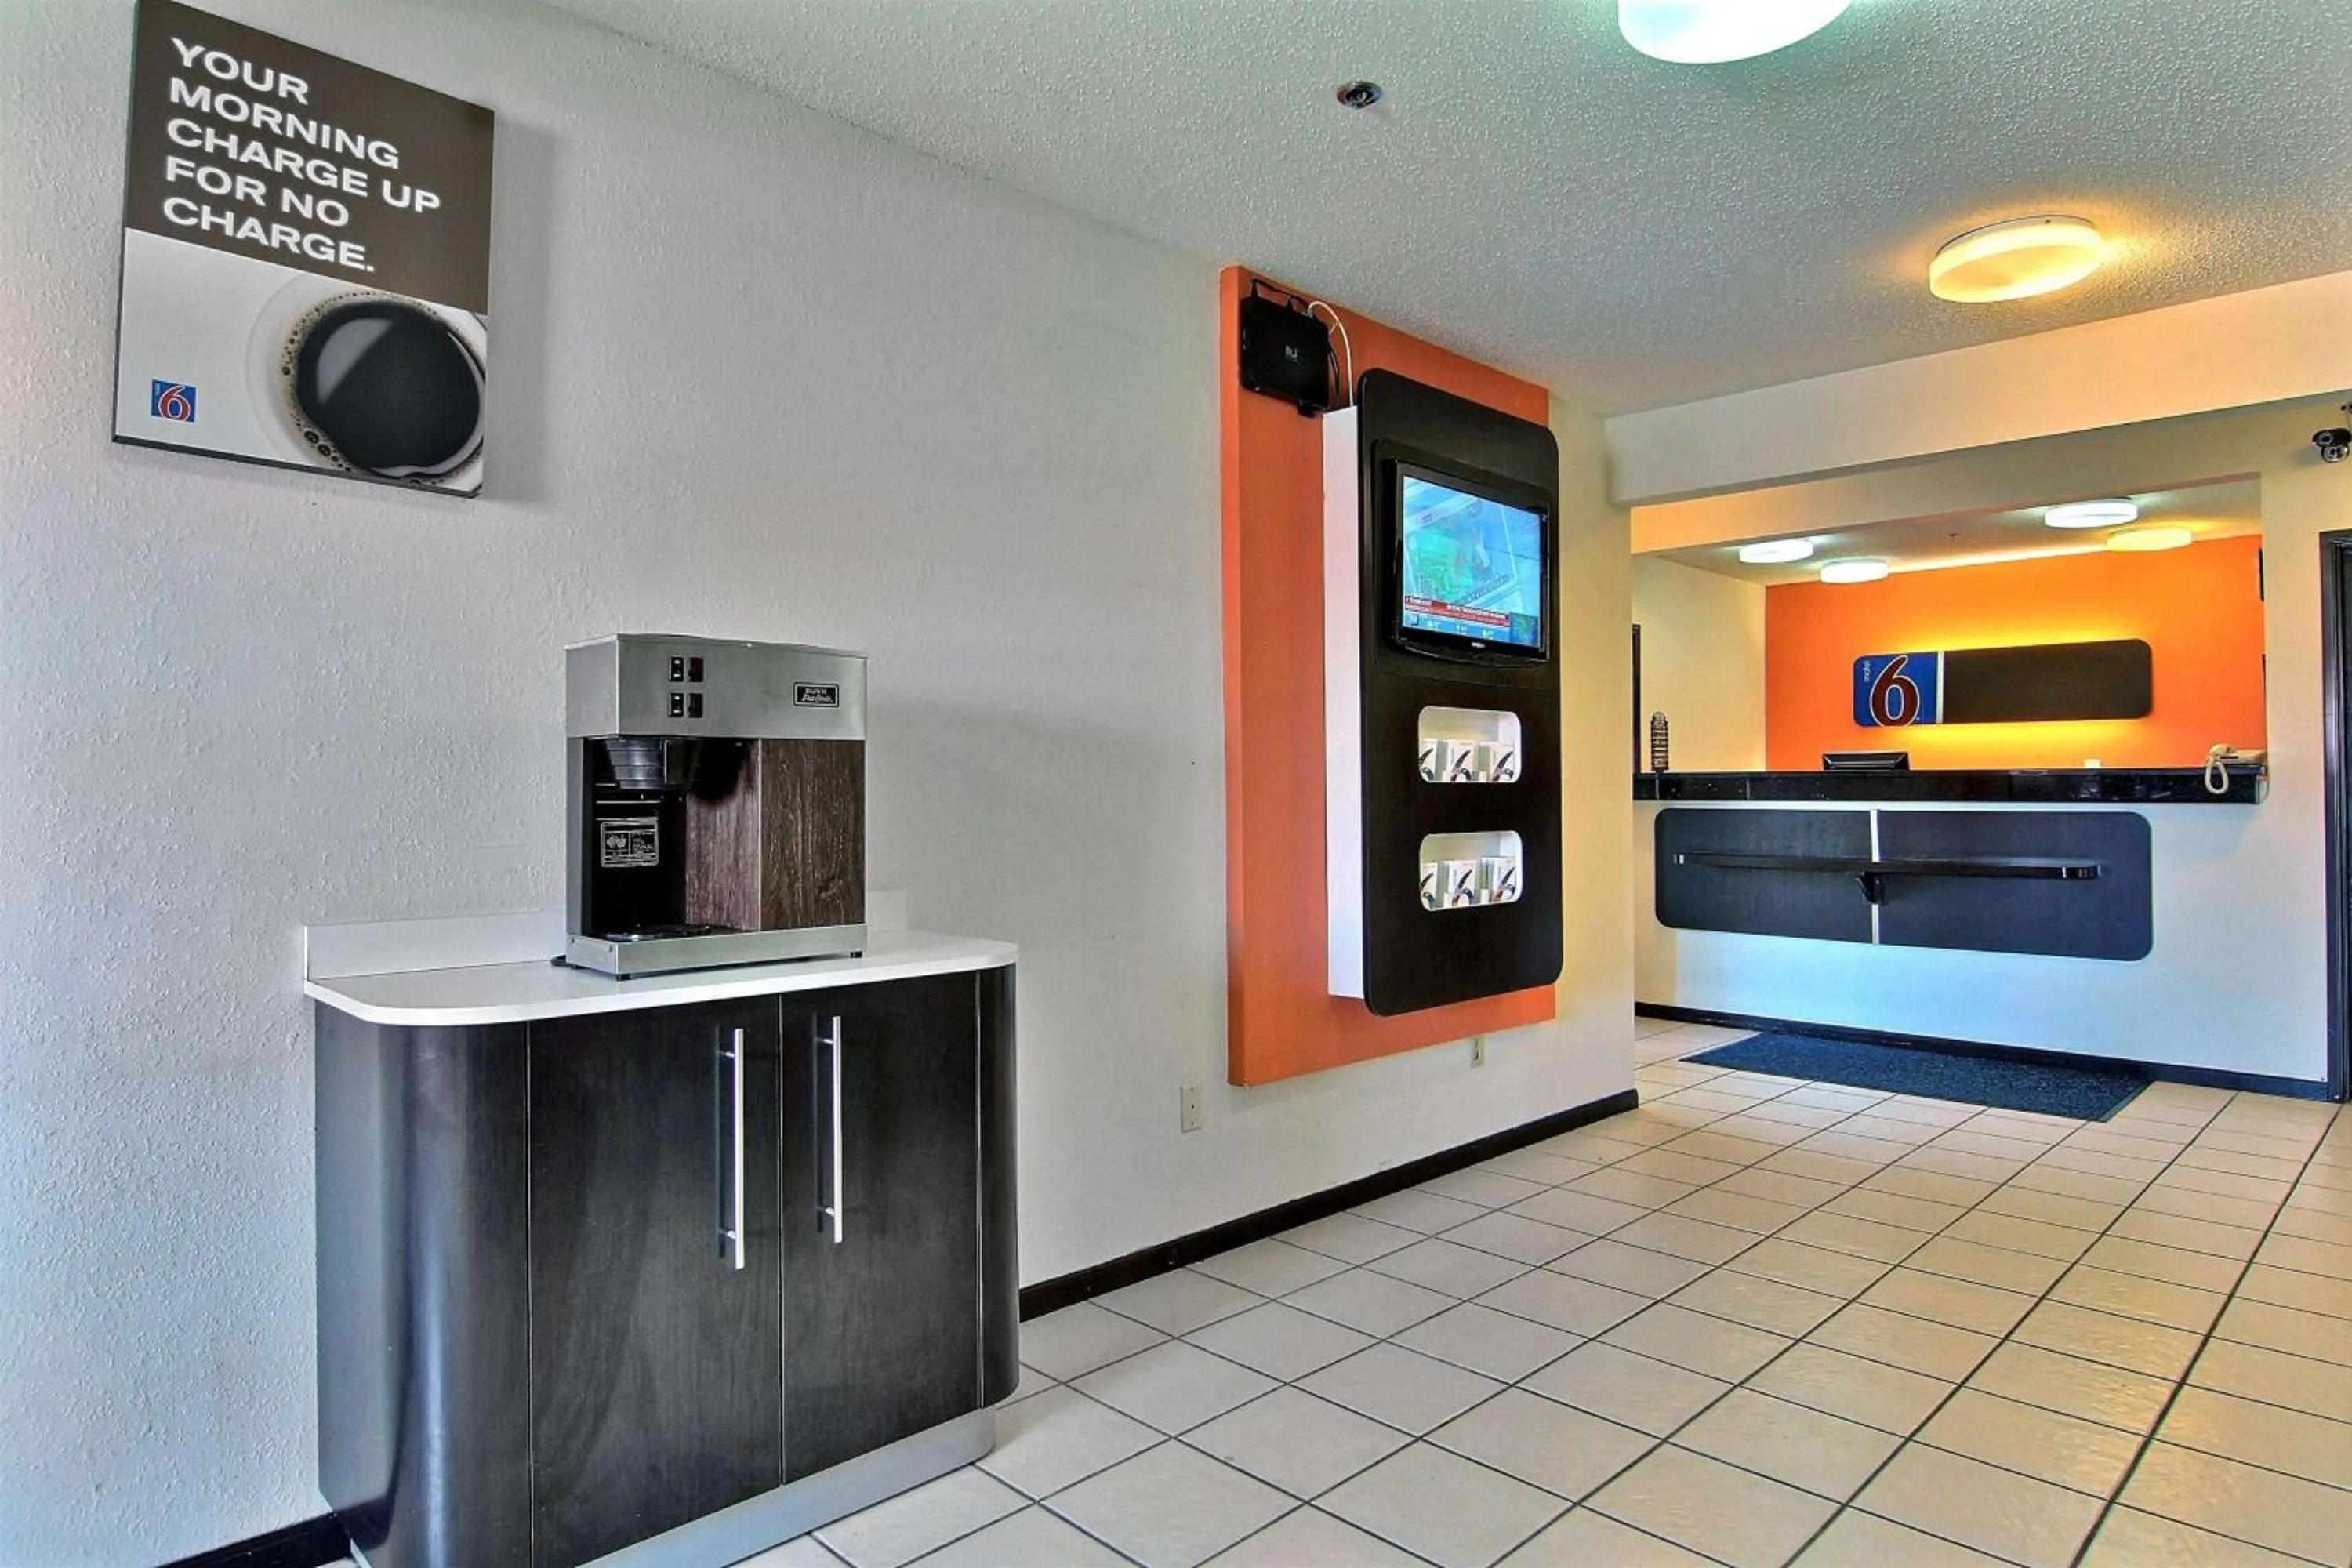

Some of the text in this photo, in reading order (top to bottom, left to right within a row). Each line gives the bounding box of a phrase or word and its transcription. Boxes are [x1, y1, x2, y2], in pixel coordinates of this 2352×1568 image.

[171, 37, 310, 105] YOUR
[170, 76, 400, 170] MORNING
[165, 155, 349, 227] FOR NO
[167, 118, 441, 213] CHARGE UP
[162, 197, 375, 271] CHARGE.
[158, 385, 191, 423] 6
[1869, 655, 1920, 727] 6
